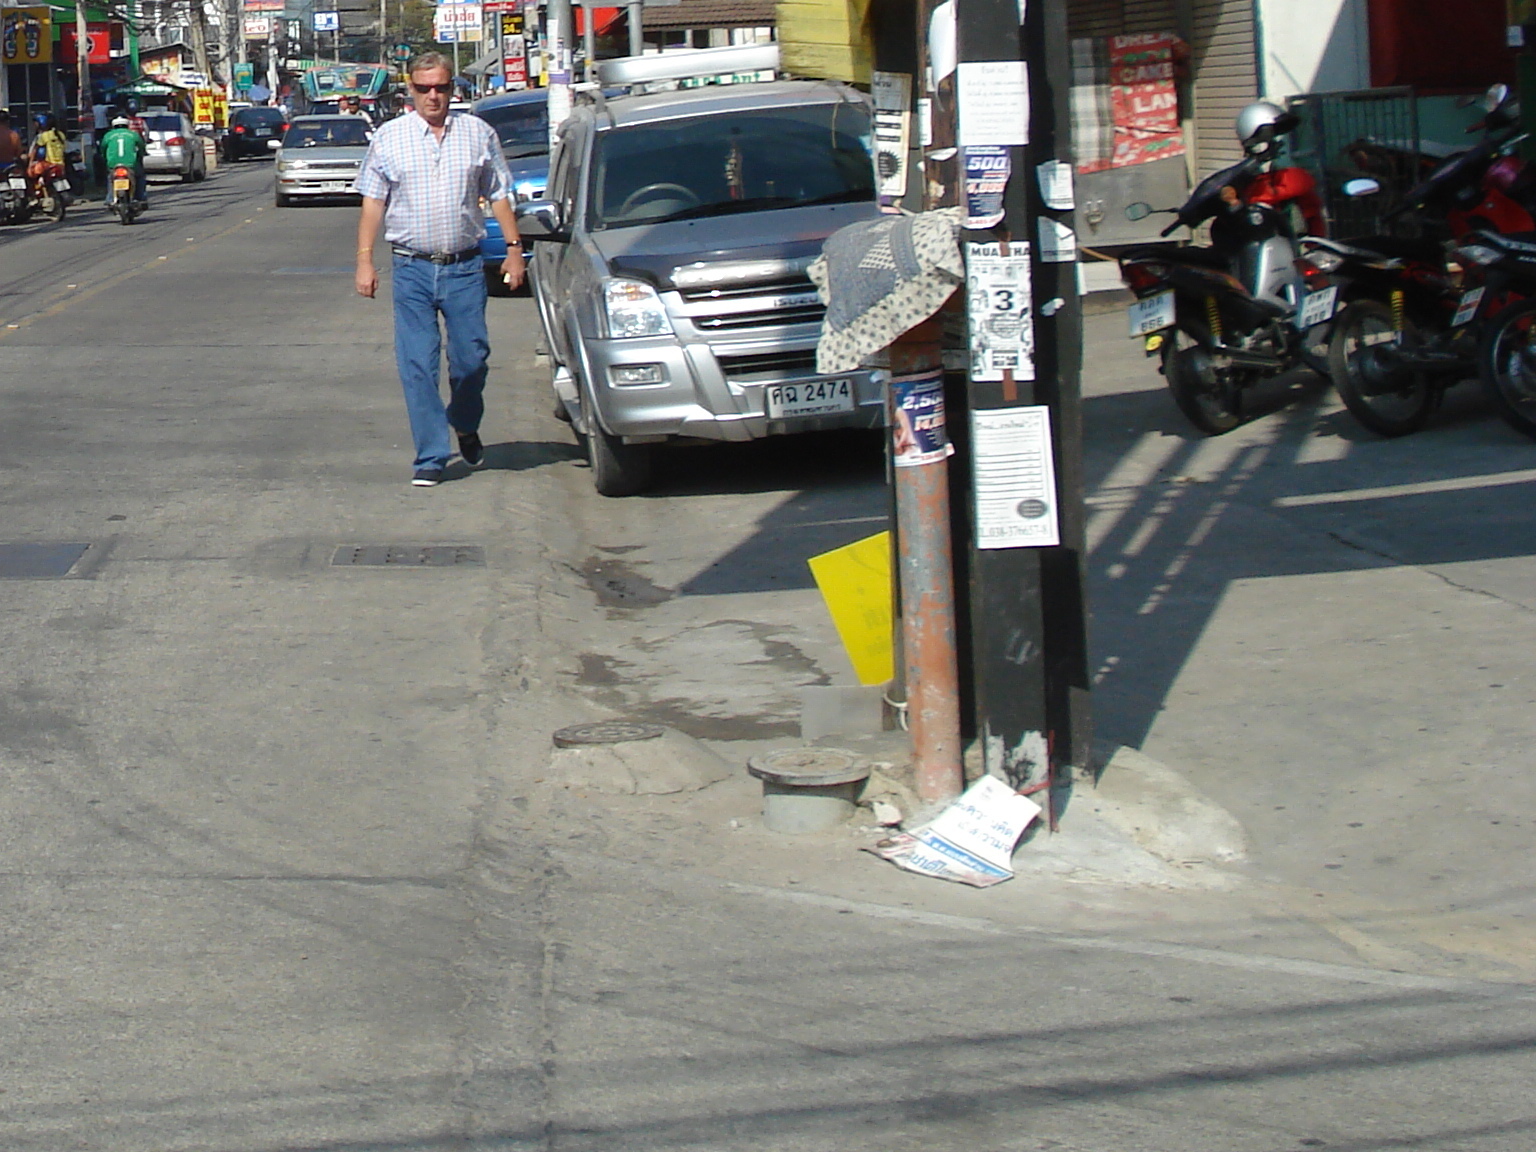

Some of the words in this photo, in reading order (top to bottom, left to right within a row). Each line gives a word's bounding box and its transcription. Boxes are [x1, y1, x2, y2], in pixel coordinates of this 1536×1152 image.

[970, 247, 1001, 257] MUA
[995, 289, 1014, 311] 3
[804, 381, 849, 402] 2474
